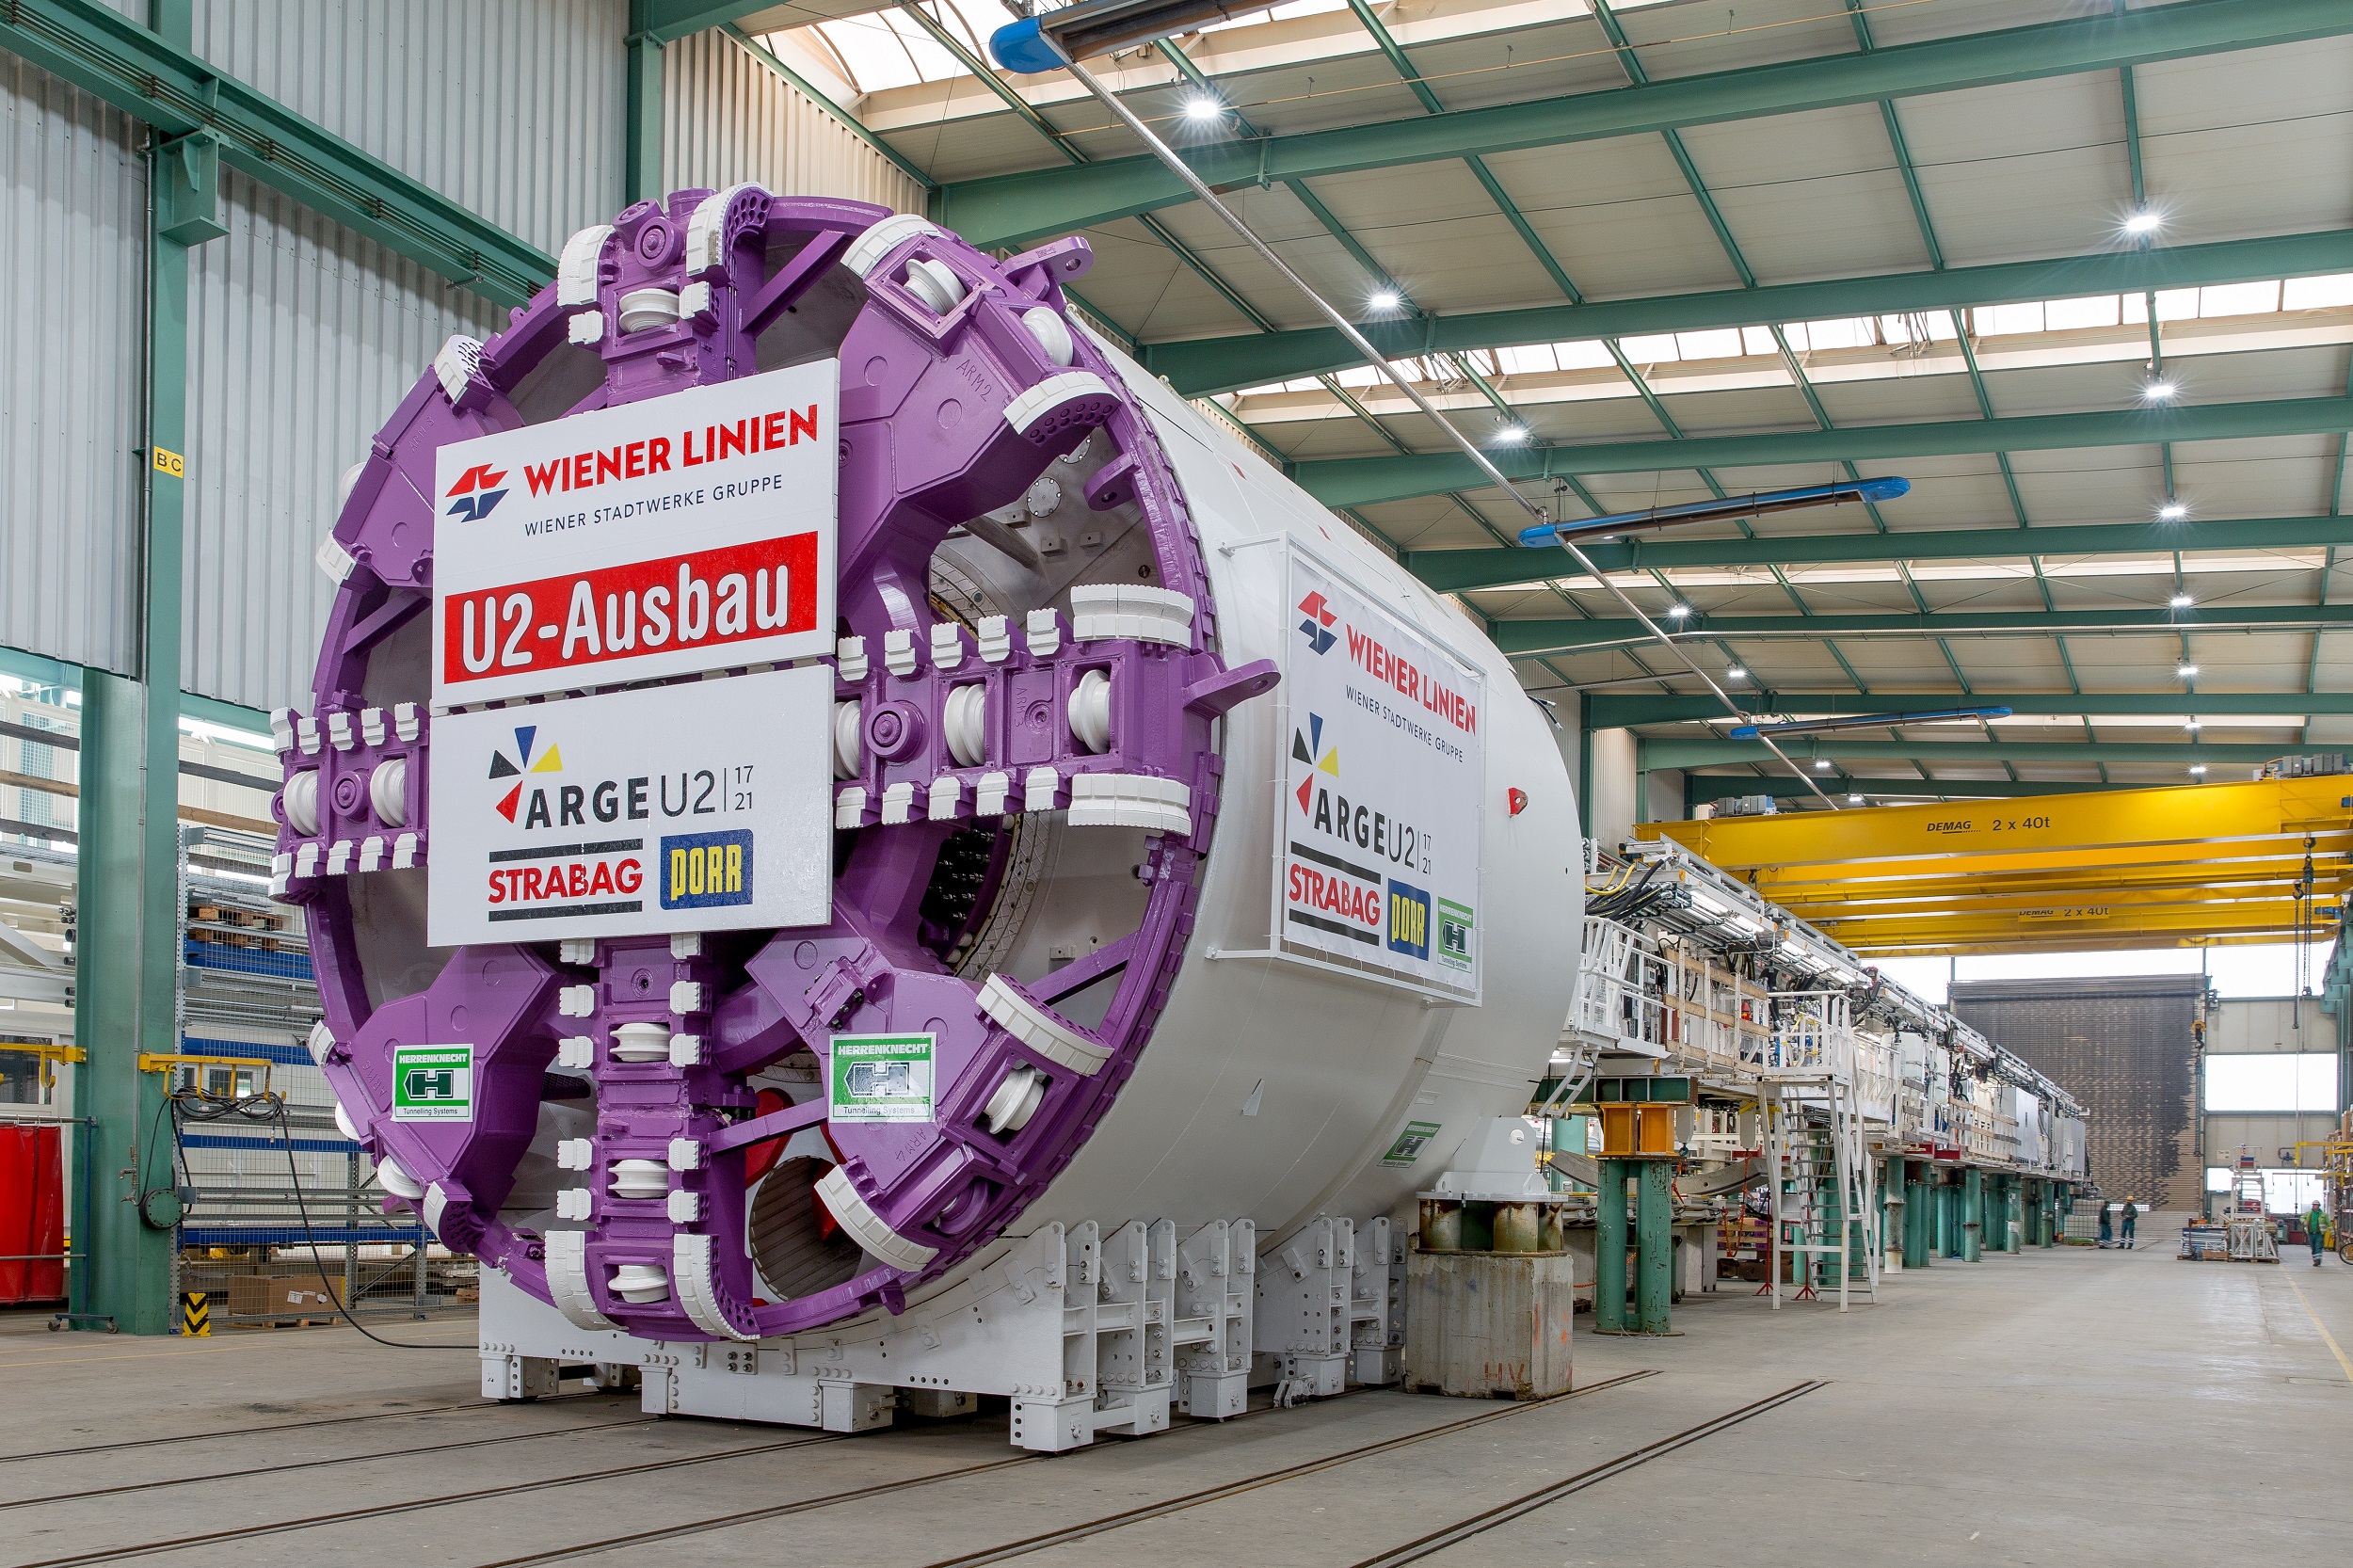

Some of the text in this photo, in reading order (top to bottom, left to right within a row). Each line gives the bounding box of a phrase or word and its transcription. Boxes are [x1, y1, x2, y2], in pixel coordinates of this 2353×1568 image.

[523, 404, 818, 499] WIENER LINIEN
[525, 474, 782, 536] WIENER STADTWERKE GRUPPE
[462, 563, 789, 673] U2-Ausbau
[1346, 623, 1476, 736] WIENER LINIEN
[1346, 685, 1463, 763] WIENER STADTWERKE GRUPPE
[735, 765, 753, 784] 17
[525, 769, 715, 830] ARGE U2
[735, 791, 753, 810] 21
[1314, 788, 1415, 869] ARGE U2
[1423, 833, 1432, 851] 17
[1927, 816, 2051, 832] DEMAG 2 x 40t
[488, 857, 643, 904] STRABAG
[670, 844, 742, 901] PORR
[1422, 857, 1431, 875] 21
[1289, 863, 1380, 926] STRABAG
[1438, 904, 1472, 922] HERRENKNECHT
[1392, 893, 1425, 948] PORR
[399, 1053, 467, 1064] HERRENKNECHT
[838, 1043, 928, 1055] HERRENKNECHT
[433, 1107, 457, 1115] Systems
[843, 1106, 915, 1115] Tunnelling Systems
